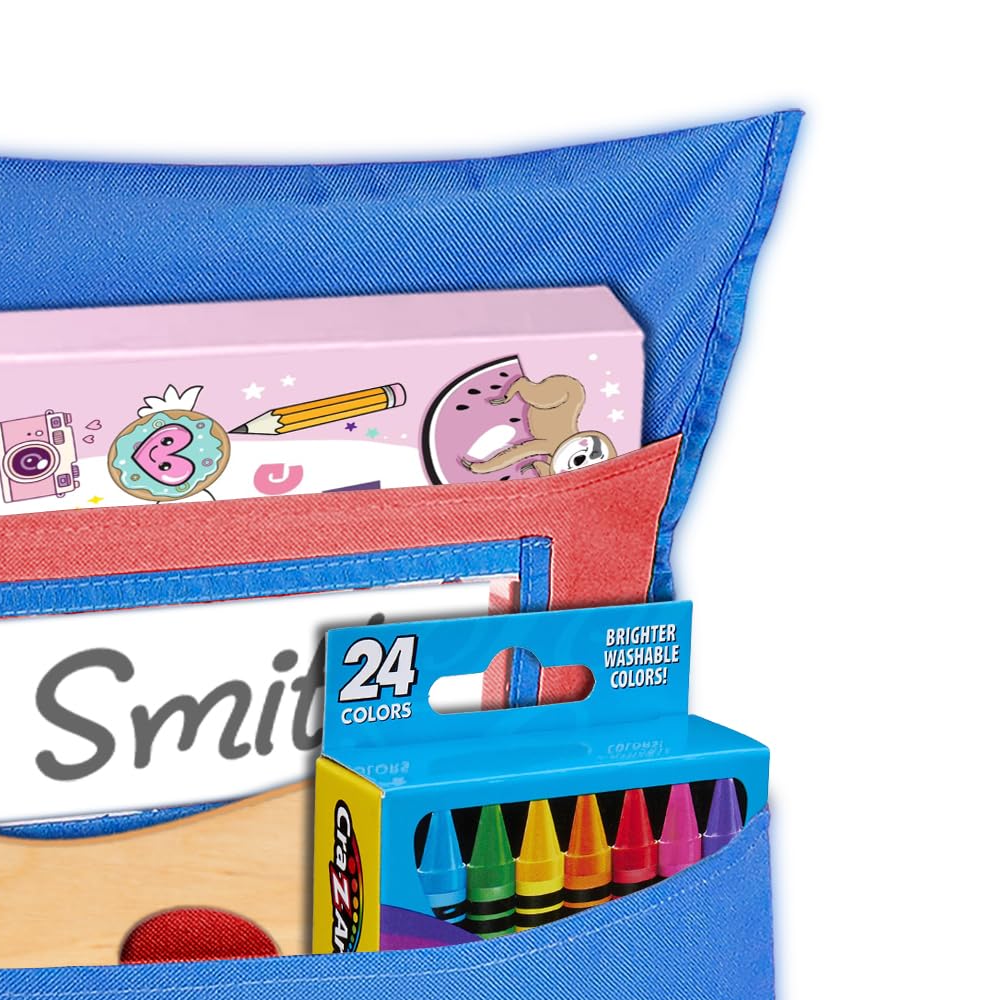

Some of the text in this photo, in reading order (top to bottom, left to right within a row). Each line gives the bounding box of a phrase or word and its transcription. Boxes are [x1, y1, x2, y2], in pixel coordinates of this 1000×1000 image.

[605, 623, 677, 648] BRIGHTER
[337, 634, 418, 702] 24
[603, 643, 680, 669] WASHABLE
[609, 668, 669, 690] COLORS!
[35, 613, 384, 781] Smit
[340, 701, 413, 725] COLORS
